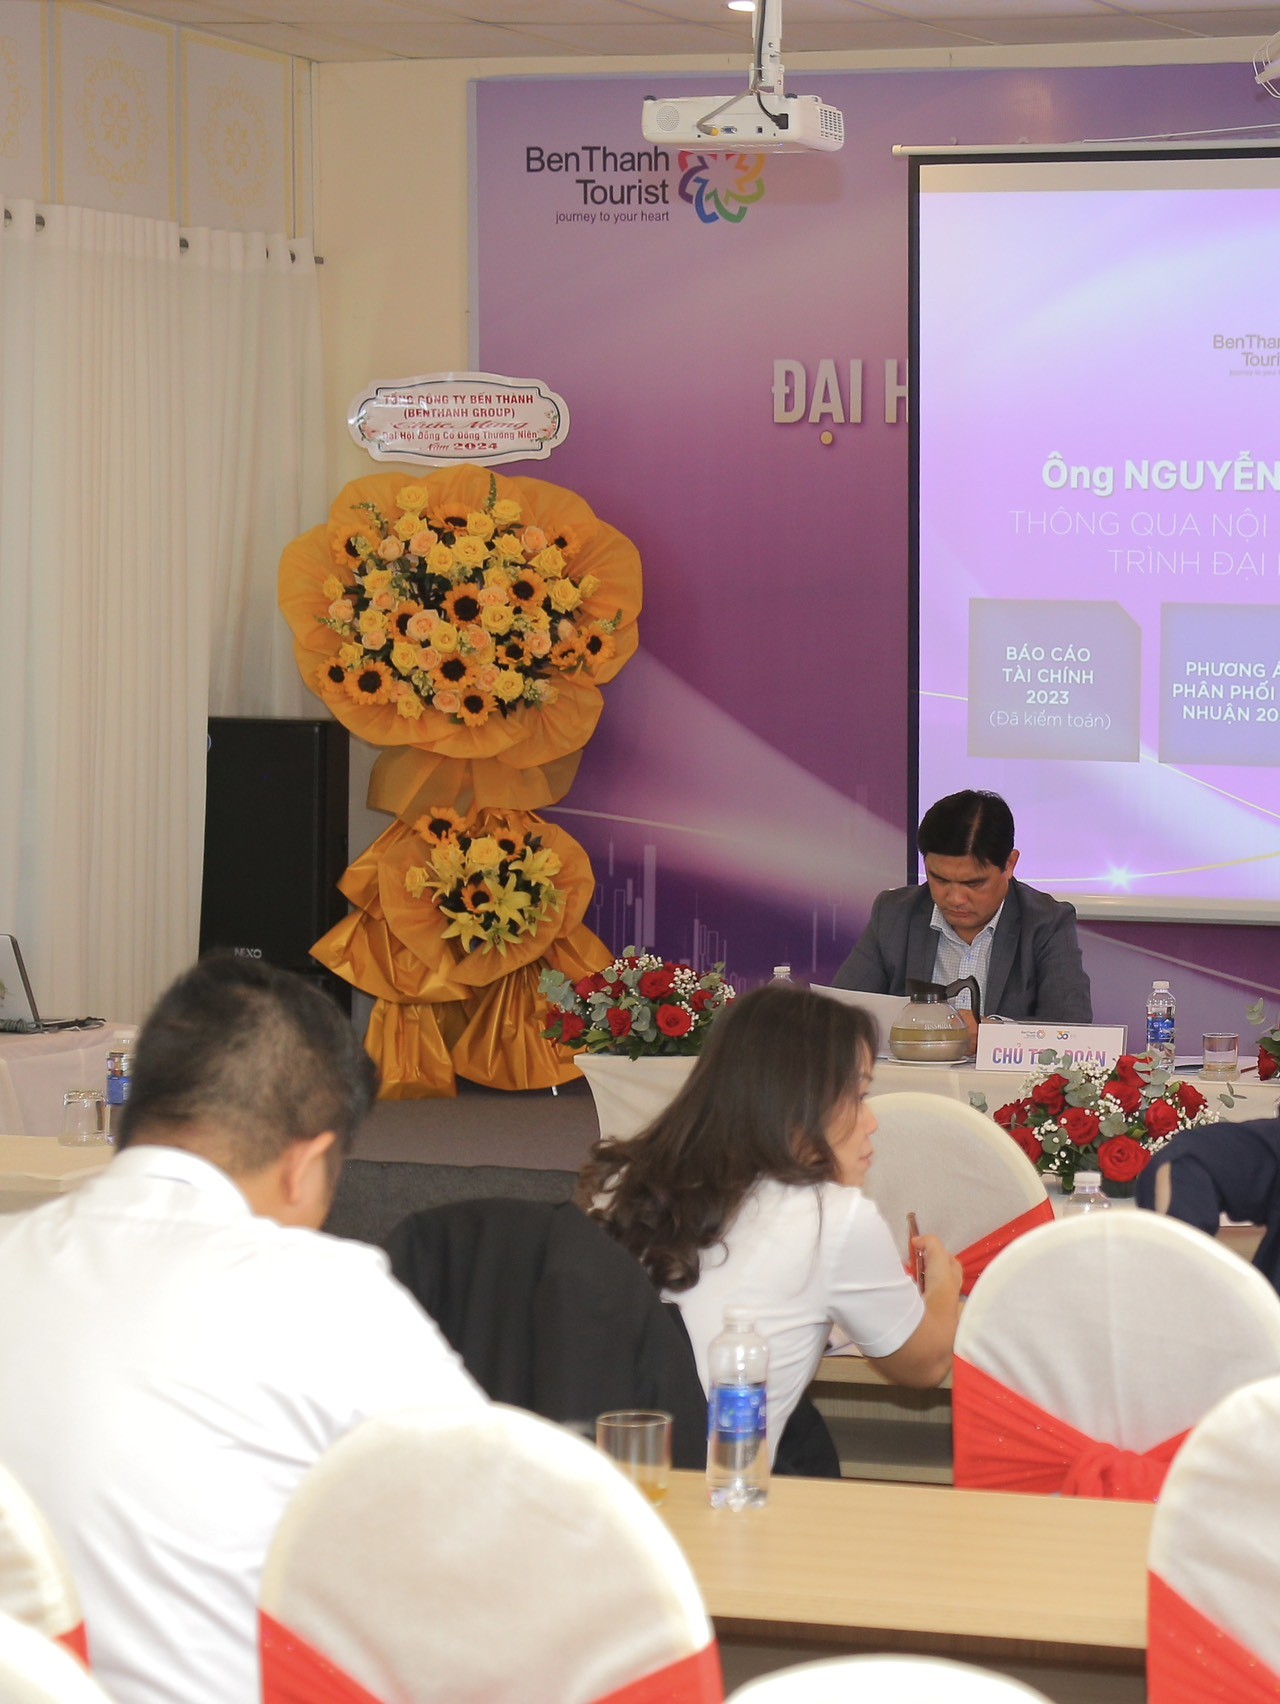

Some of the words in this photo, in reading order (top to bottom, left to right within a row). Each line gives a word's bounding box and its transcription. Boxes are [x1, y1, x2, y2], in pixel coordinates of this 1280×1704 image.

[526, 146, 669, 173] BenThanh
[575, 179, 669, 205] Tourist
[555, 211, 596, 224] journey
[600, 211, 610, 222] to
[613, 214, 637, 224] your
[640, 211, 669, 222] heart
[418, 392, 449, 405] CÔNG
[453, 394, 466, 405] TY
[470, 390, 493, 405] BẾN
[496, 392, 533, 405] THÀNH
[771, 359, 863, 445] ĐẠI
[404, 408, 469, 419] (BENTHANH
[472, 408, 515, 419] GROUP)
[453, 441, 498, 450] 2024
[1042, 451, 1114, 496] Ông
[1009, 506, 1120, 536] THÔNG
[1131, 512, 1201, 537] QUA
[1212, 507, 1267, 543] NỘI
[1108, 546, 1200, 575] TRÌNH
[1211, 550, 1264, 581] ĐẠI
[1006, 643, 1045, 661] BÁO
[1051, 644, 1091, 662] CÁO
[1002, 665, 1031, 682] TÀI
[1037, 666, 1094, 684] CHÍNH
[1186, 661, 1266, 678] PHƯƠNG
[1026, 689, 1069, 705] 2023
[1172, 680, 1224, 699] PHÂN
[1230, 680, 1275, 701] PHỐI
[989, 710, 1019, 728] (Đã
[1024, 710, 1061, 726] kiểm
[1068, 713, 1111, 730] toán)
[1183, 702, 1250, 724] NHUẬN
[993, 1042, 1024, 1065] CHỦ
